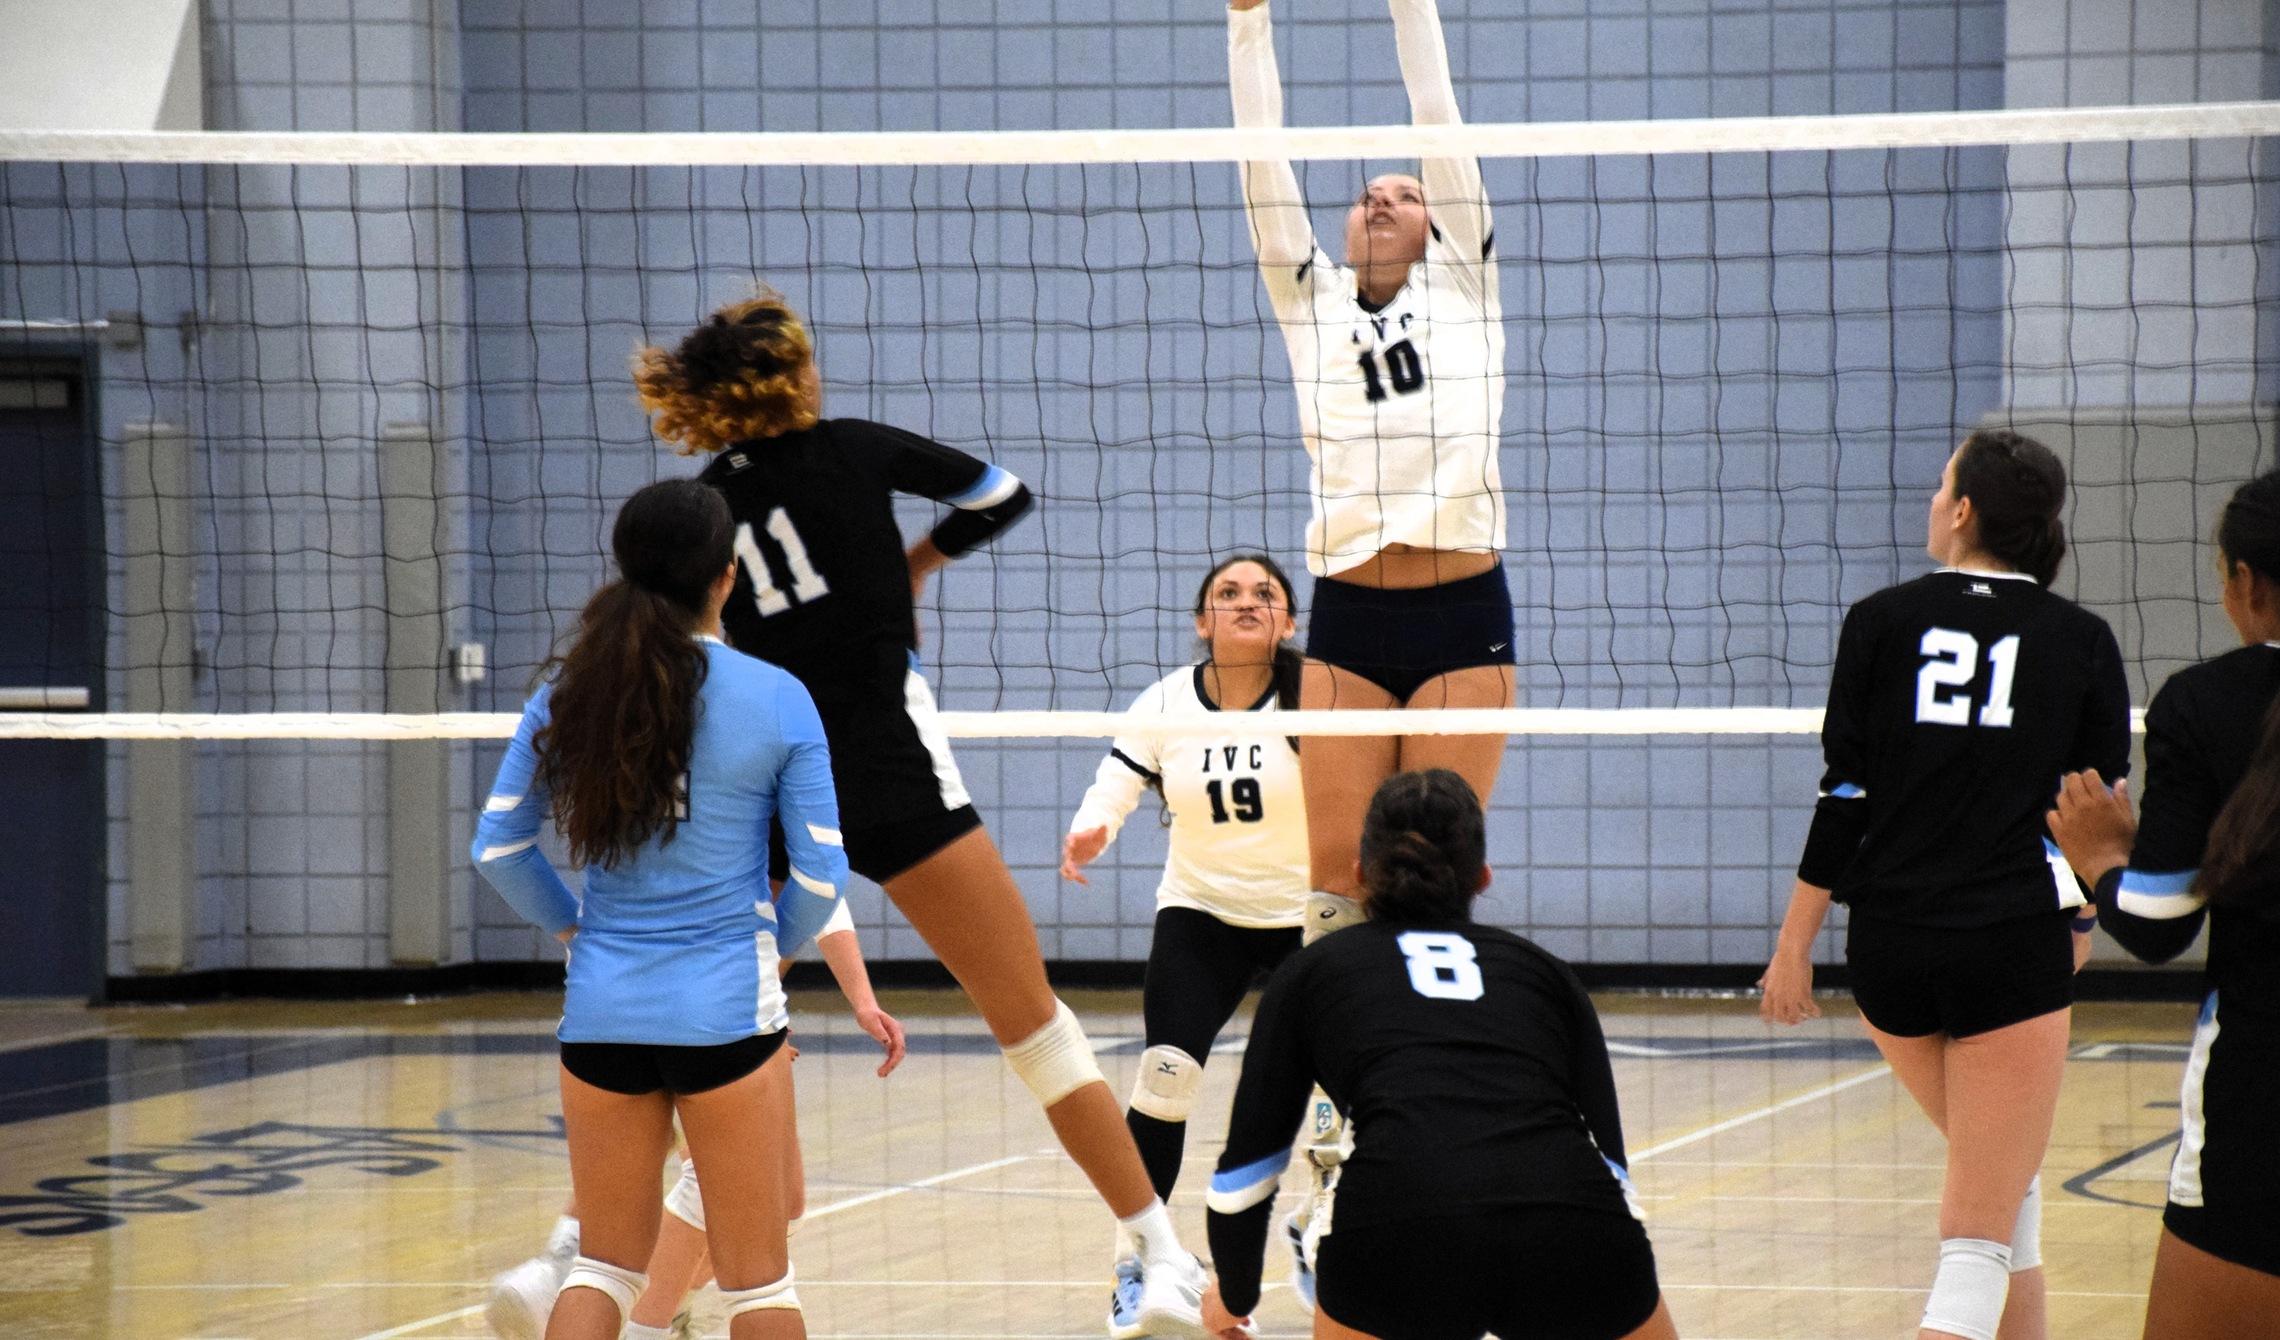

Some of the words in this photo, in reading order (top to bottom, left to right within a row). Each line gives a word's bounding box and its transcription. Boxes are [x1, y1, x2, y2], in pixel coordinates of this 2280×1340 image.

[1358, 338, 1425, 403] 10
[733, 506, 831, 618] 11
[1915, 626, 2021, 727] 21
[1202, 744, 1262, 772] IVC
[1206, 777, 1264, 824] 19
[1396, 931, 1485, 1001] 8
